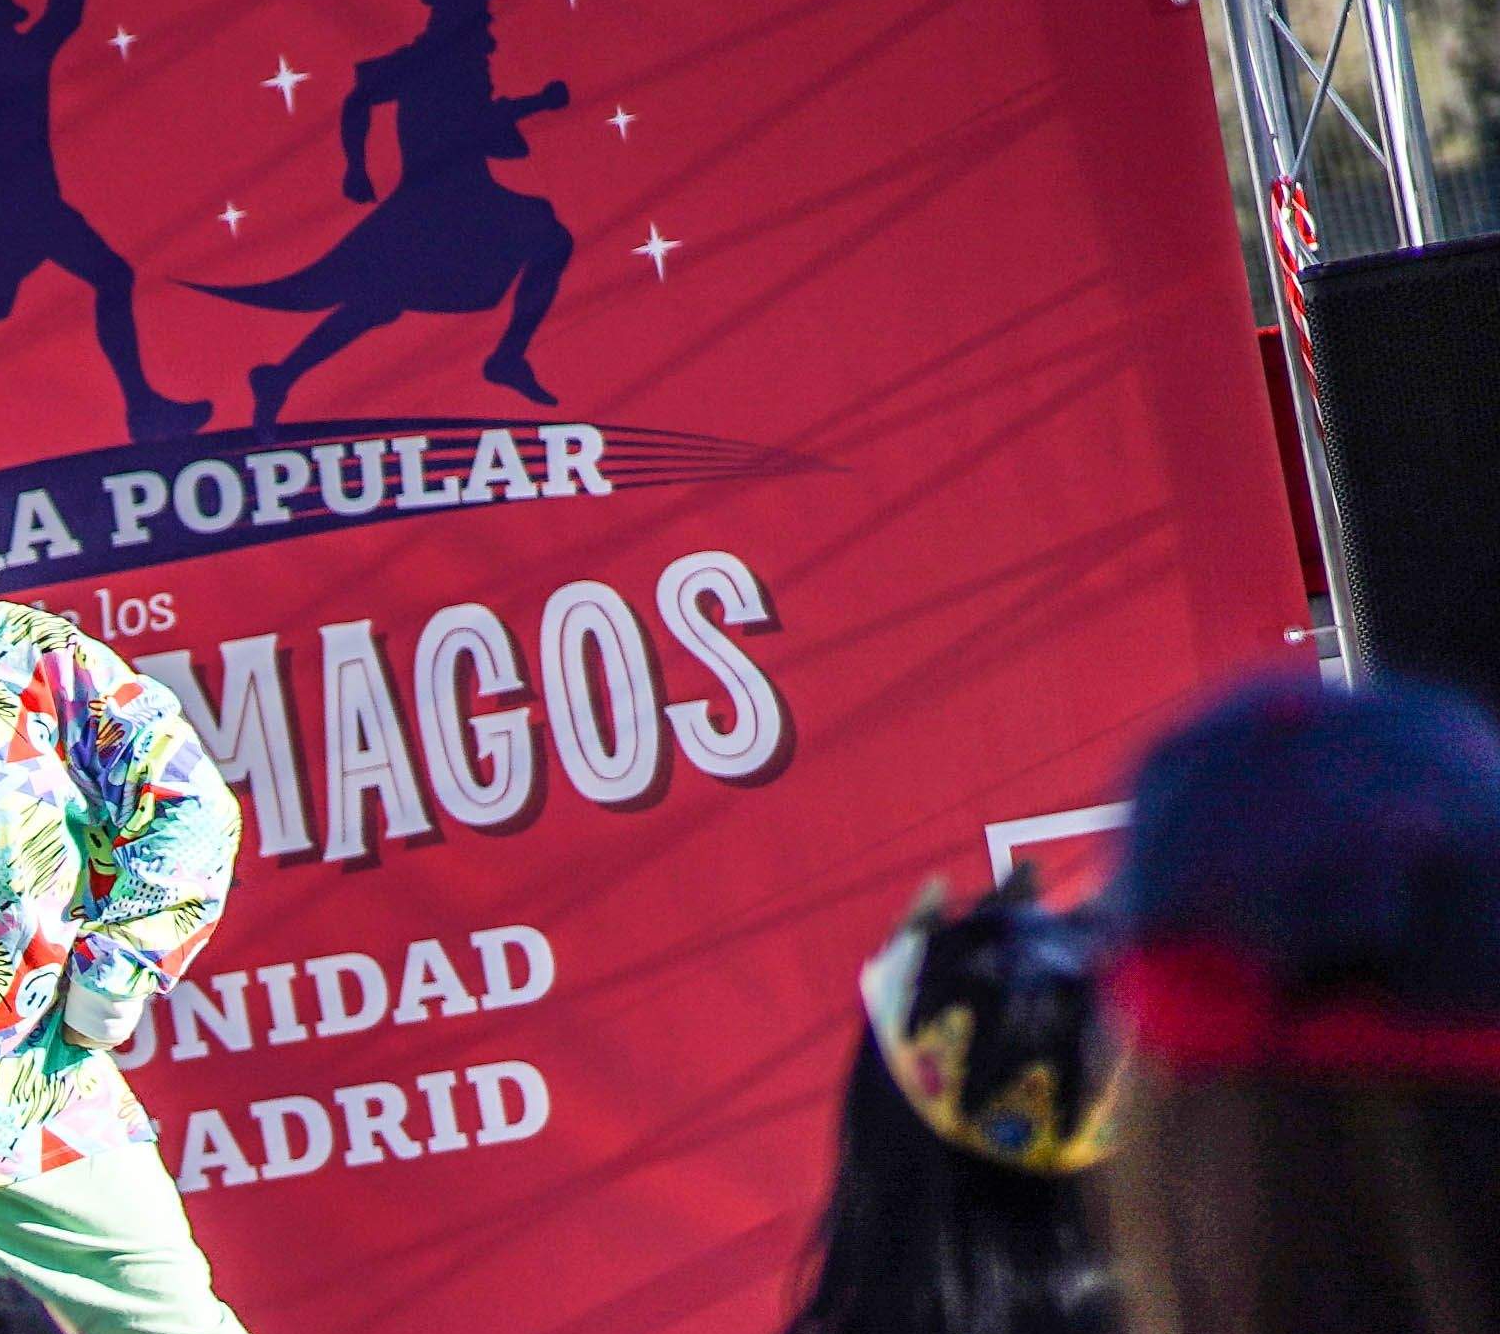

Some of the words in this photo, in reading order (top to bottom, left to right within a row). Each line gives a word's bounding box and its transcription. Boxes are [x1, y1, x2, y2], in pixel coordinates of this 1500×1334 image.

[102, 423, 613, 548] POPULAR
[94, 587, 176, 641] los
[132, 550, 782, 863] MAGOS
[152, 1059, 551, 1195] ADRID
